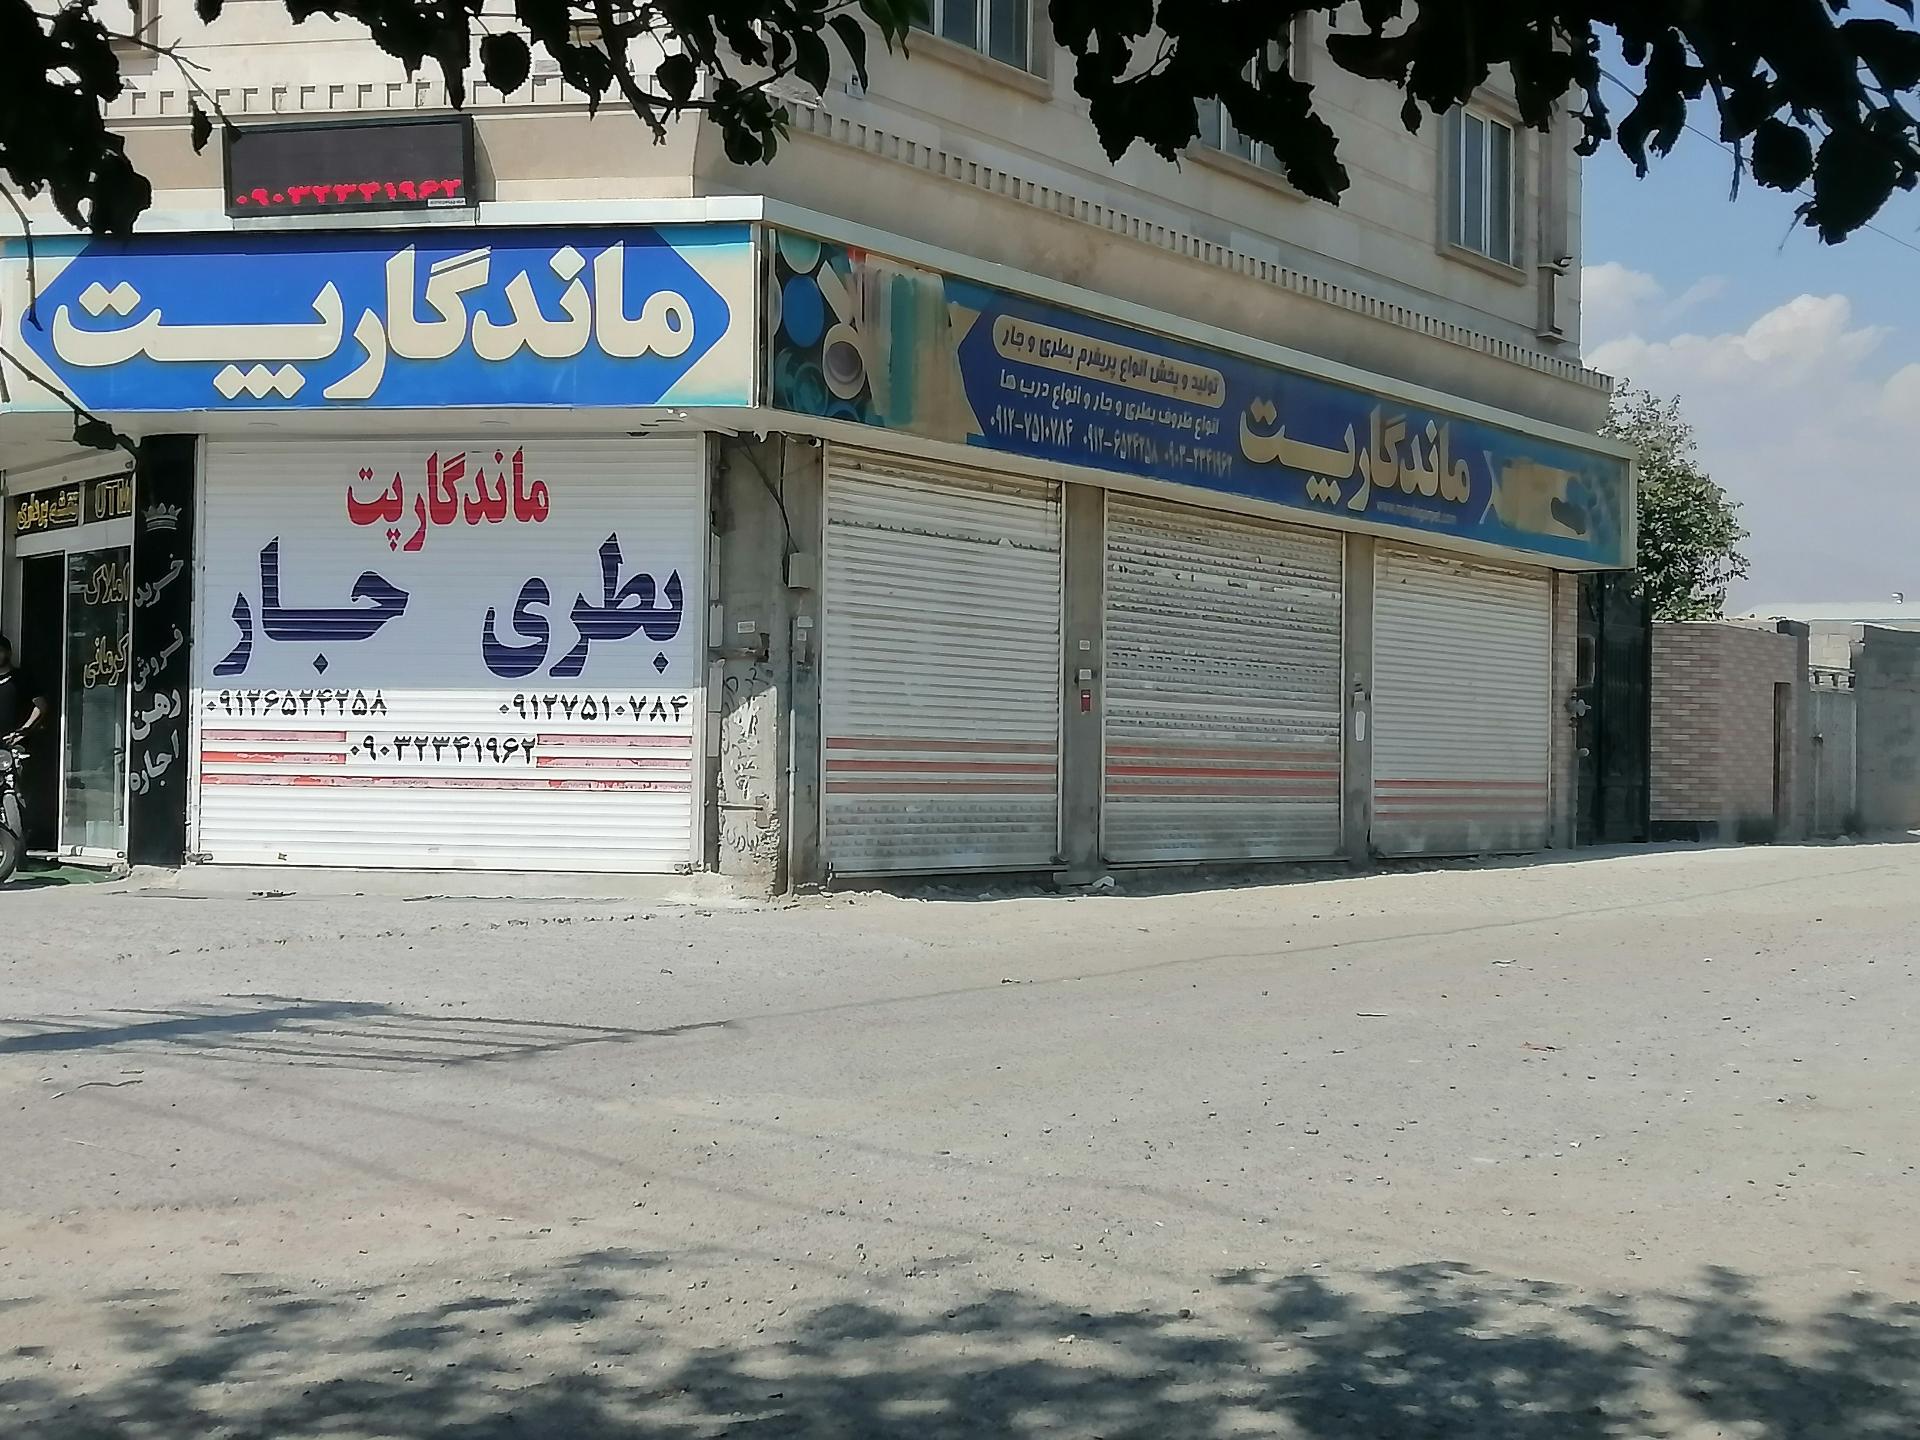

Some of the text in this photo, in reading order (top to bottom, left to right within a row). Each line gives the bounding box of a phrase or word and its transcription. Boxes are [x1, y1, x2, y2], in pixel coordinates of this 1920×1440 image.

[1002, 325, 1025, 352] جار
[1027, 335, 1037, 353] و
[1039, 337, 1075, 364] بطری
[1119, 354, 1148, 383] انواع
[1149, 359, 1180, 393] پخش
[1181, 373, 1189, 390] و
[1051, 381, 1082, 411] انواع
[1192, 374, 1219, 396] تولید
[1083, 392, 1091, 410] و
[1115, 400, 1122, 417] و
[1124, 401, 1157, 425] بطری
[1158, 407, 1194, 429] ظروف
[1194, 415, 1220, 441] انواع
[85, 561, 130, 605] املاک
[135, 553, 183, 607] خرید
[212, 535, 411, 677] جار
[481, 532, 684, 678] بطری
[133, 623, 183, 691] فروش
[131, 688, 181, 741] رهن
[499, 693, 689, 722] ۰۹۱۲۷۵۱۰۷۸۴
[130, 728, 180, 795] اجاره
